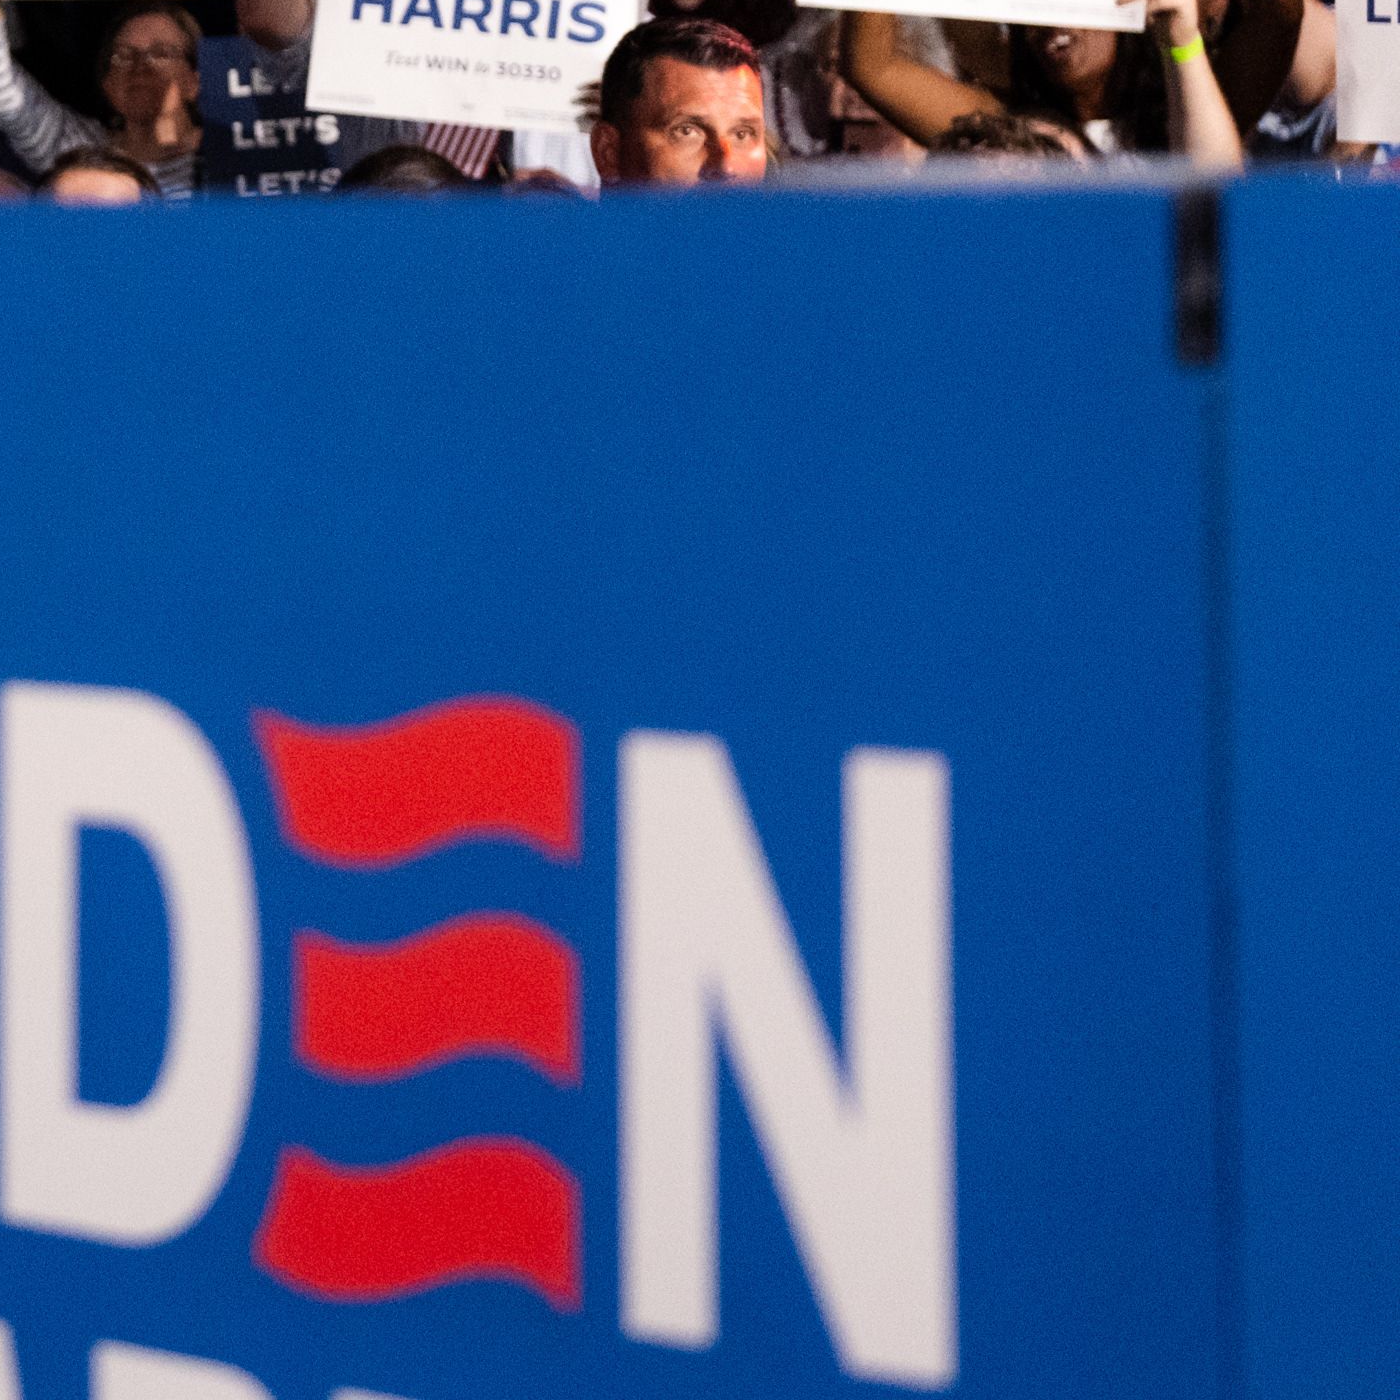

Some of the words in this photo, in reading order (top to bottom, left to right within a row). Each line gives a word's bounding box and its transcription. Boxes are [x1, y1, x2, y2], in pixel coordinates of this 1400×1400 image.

[424, 54, 471, 74] WIN
[494, 60, 563, 83] 30330
[232, 114, 341, 150] LET'S
